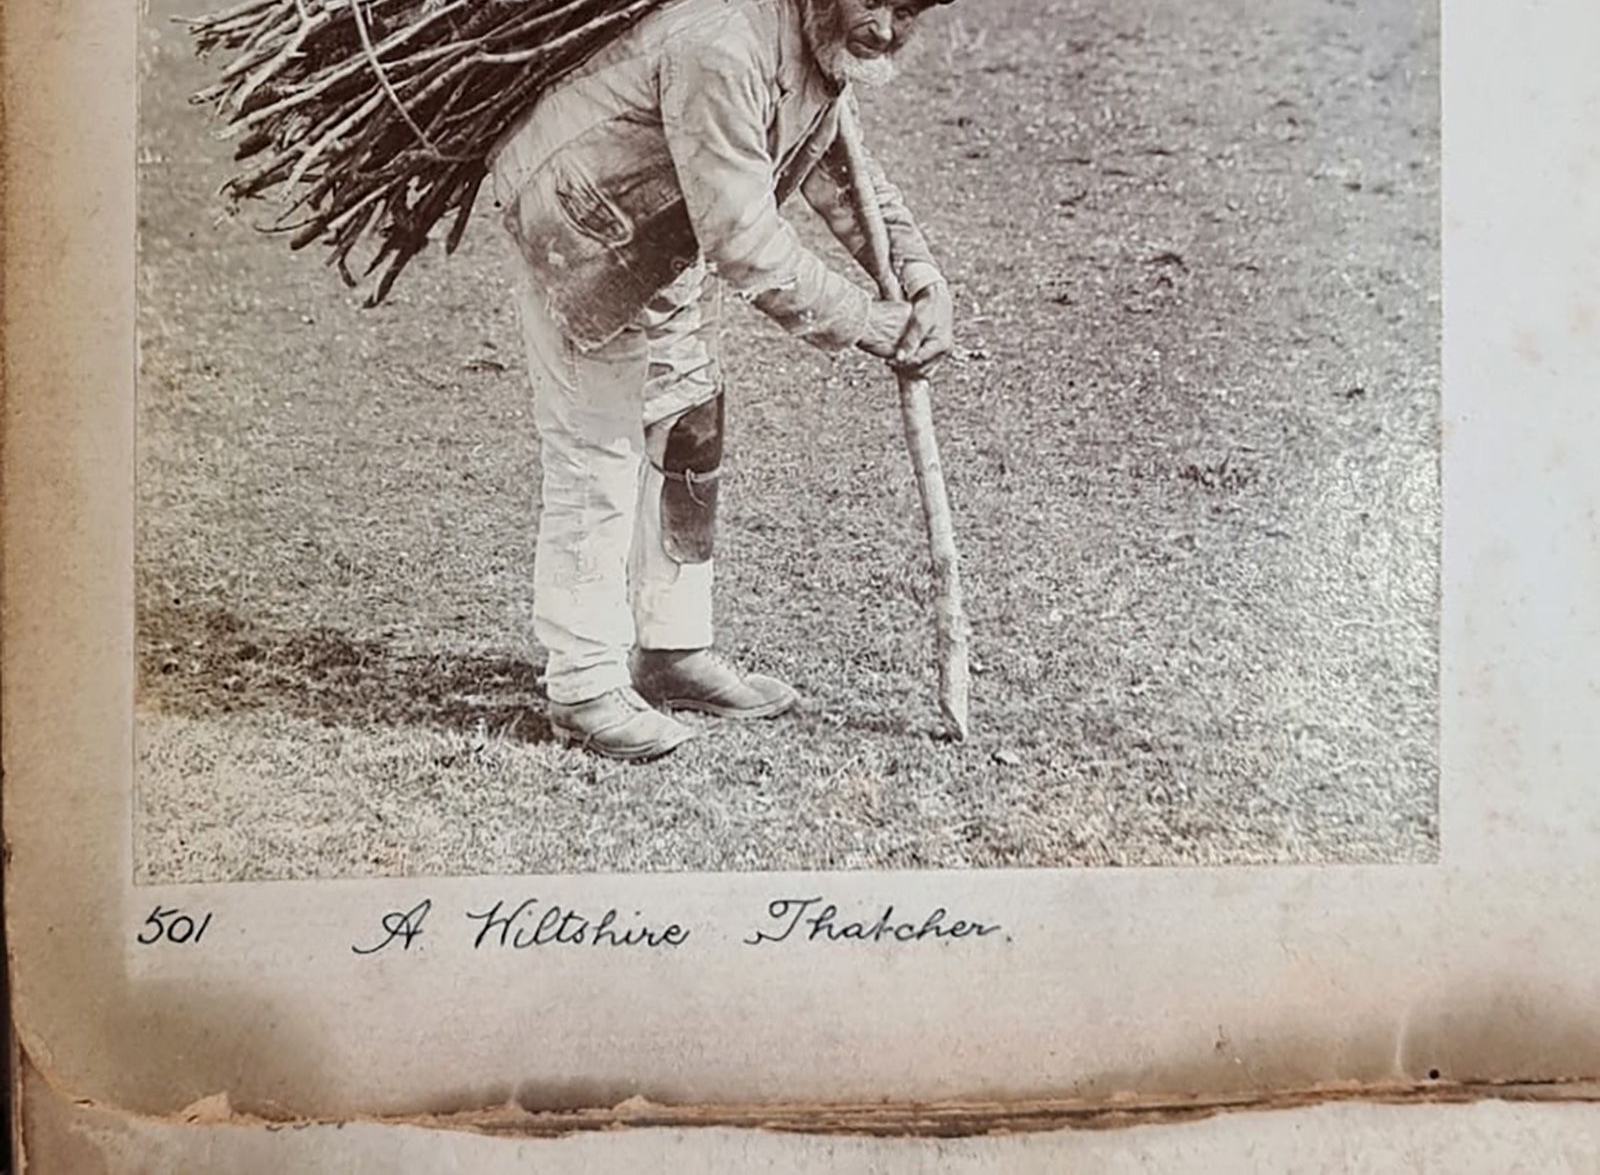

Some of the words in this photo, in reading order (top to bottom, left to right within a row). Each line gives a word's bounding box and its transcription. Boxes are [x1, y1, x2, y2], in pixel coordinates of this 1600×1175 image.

[136, 904, 213, 946] 501
[351, 898, 433, 955] A
[465, 897, 691, 950] Wiltshire
[742, 895, 1014, 946] Thatcher.
